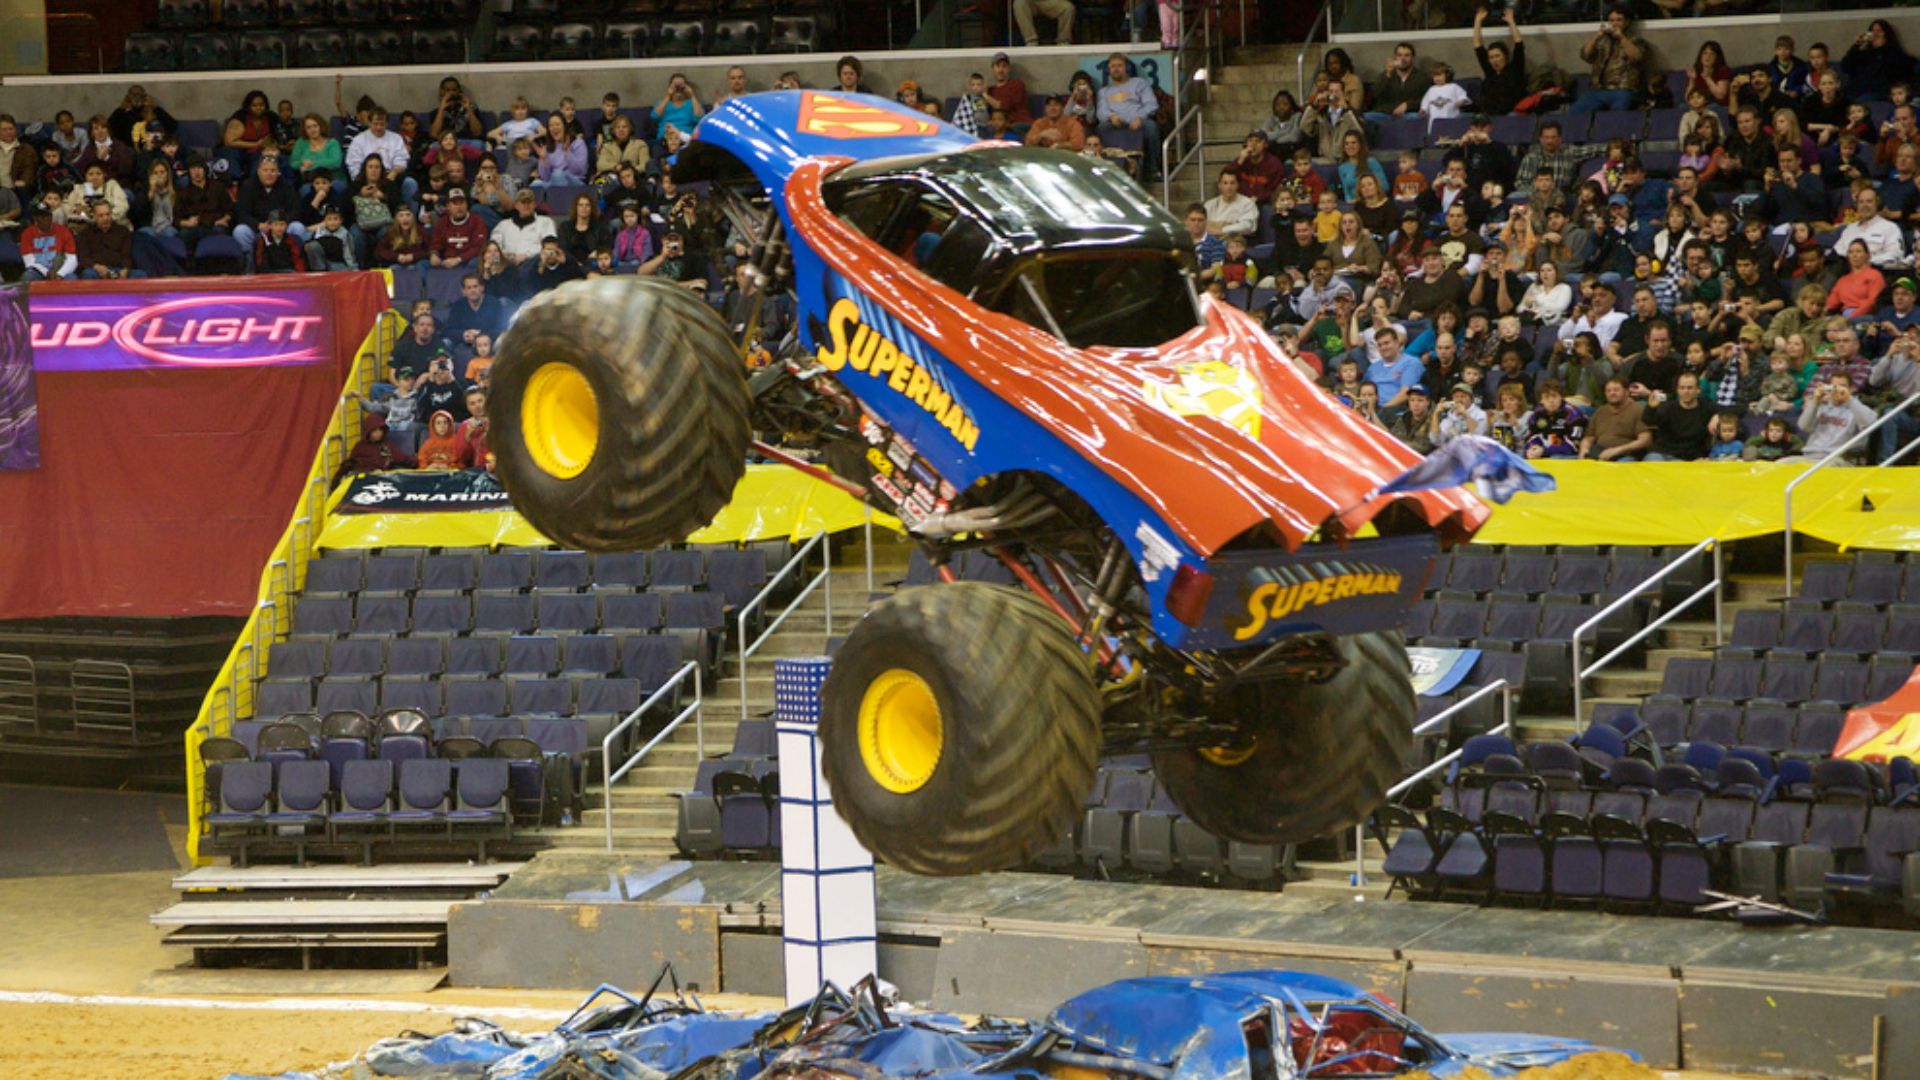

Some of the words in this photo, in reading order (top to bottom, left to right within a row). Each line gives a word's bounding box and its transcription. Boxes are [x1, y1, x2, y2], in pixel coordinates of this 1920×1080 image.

[31, 322, 112, 348] UD
[143, 315, 322, 346] LIGHT
[817, 298, 981, 452] SUPERMAN
[1234, 572, 1402, 641] SUPERMAN
